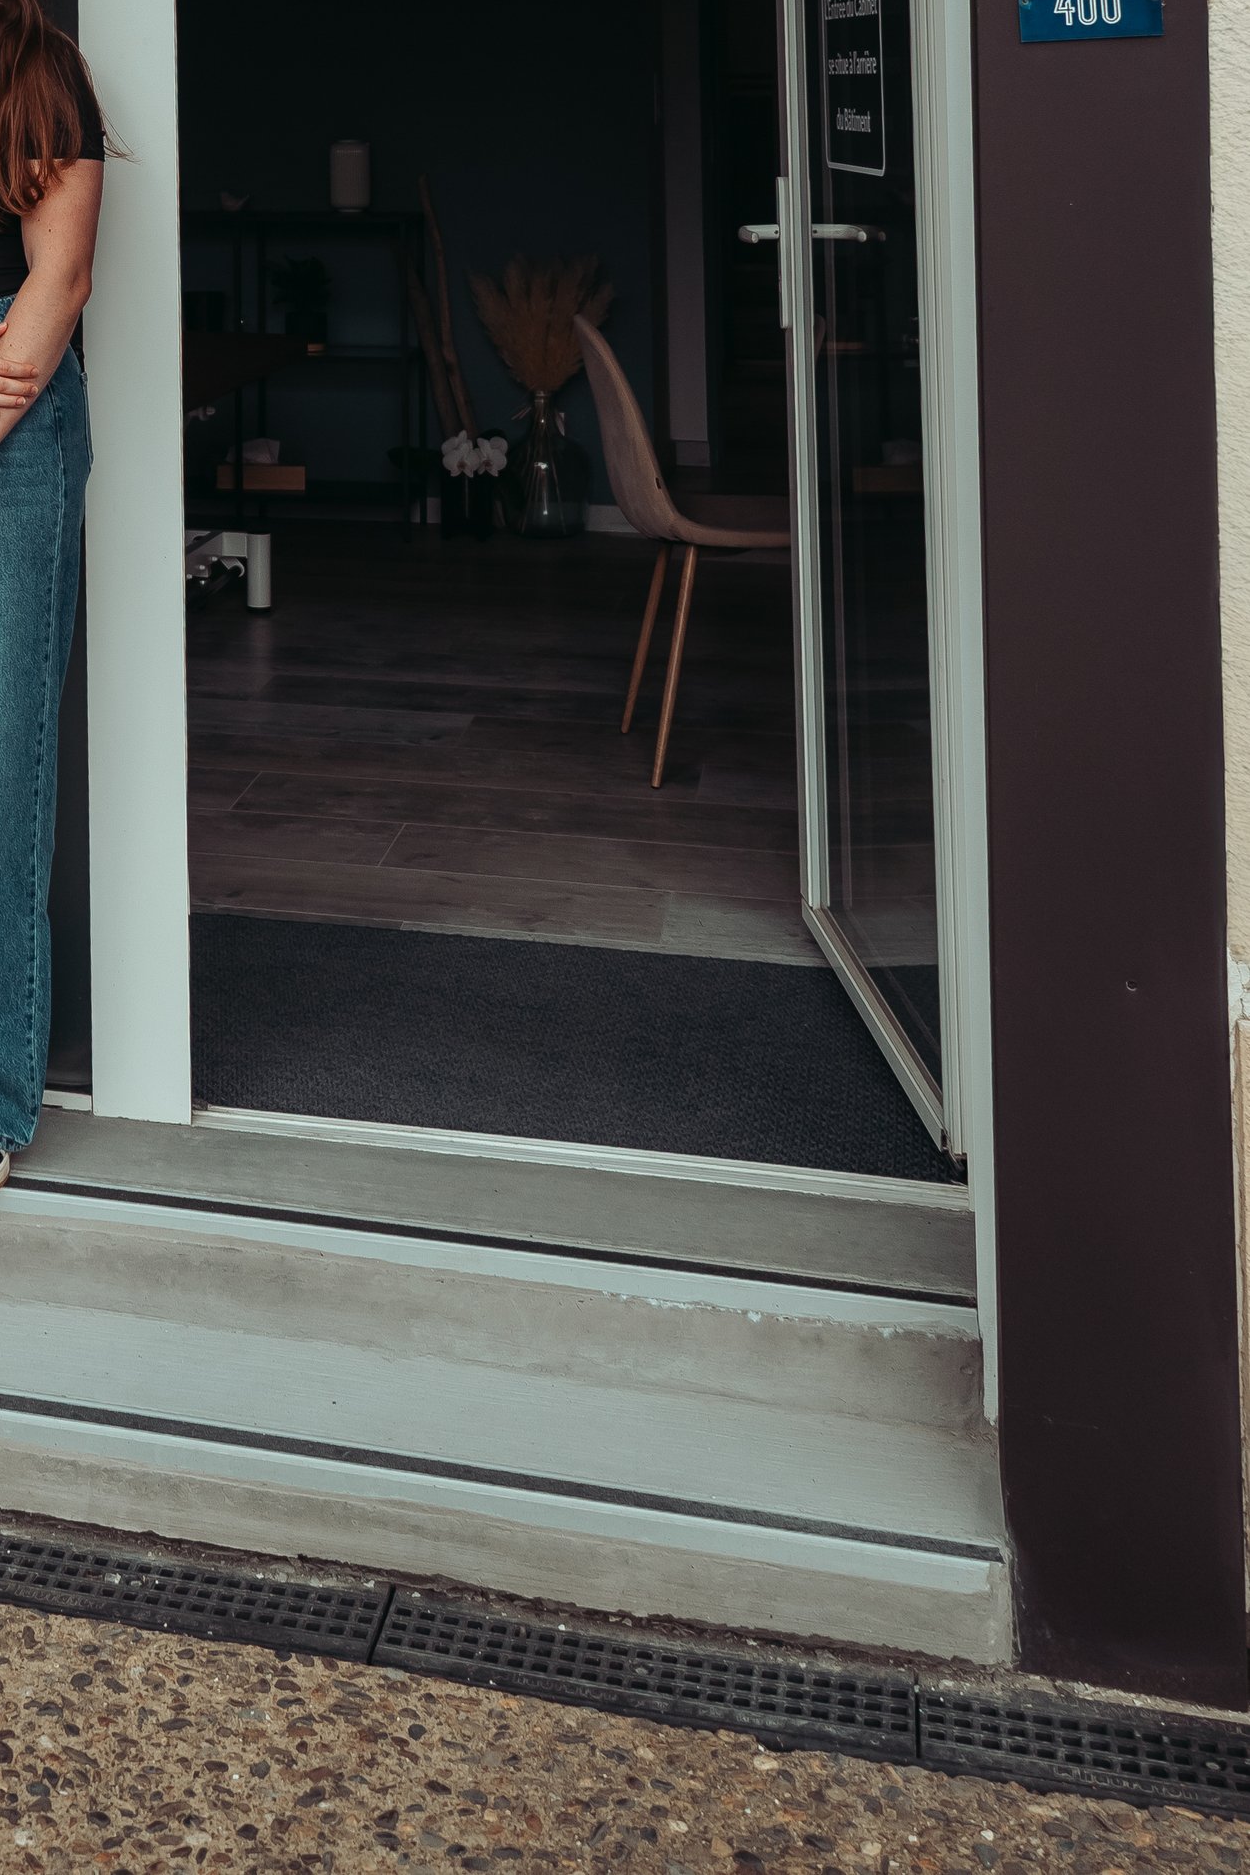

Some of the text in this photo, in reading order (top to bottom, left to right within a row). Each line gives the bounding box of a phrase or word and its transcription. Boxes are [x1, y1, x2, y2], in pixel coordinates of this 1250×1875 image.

[828, 51, 877, 74] se situe à l'arrière
[836, 108, 871, 132] du Bâtiment
